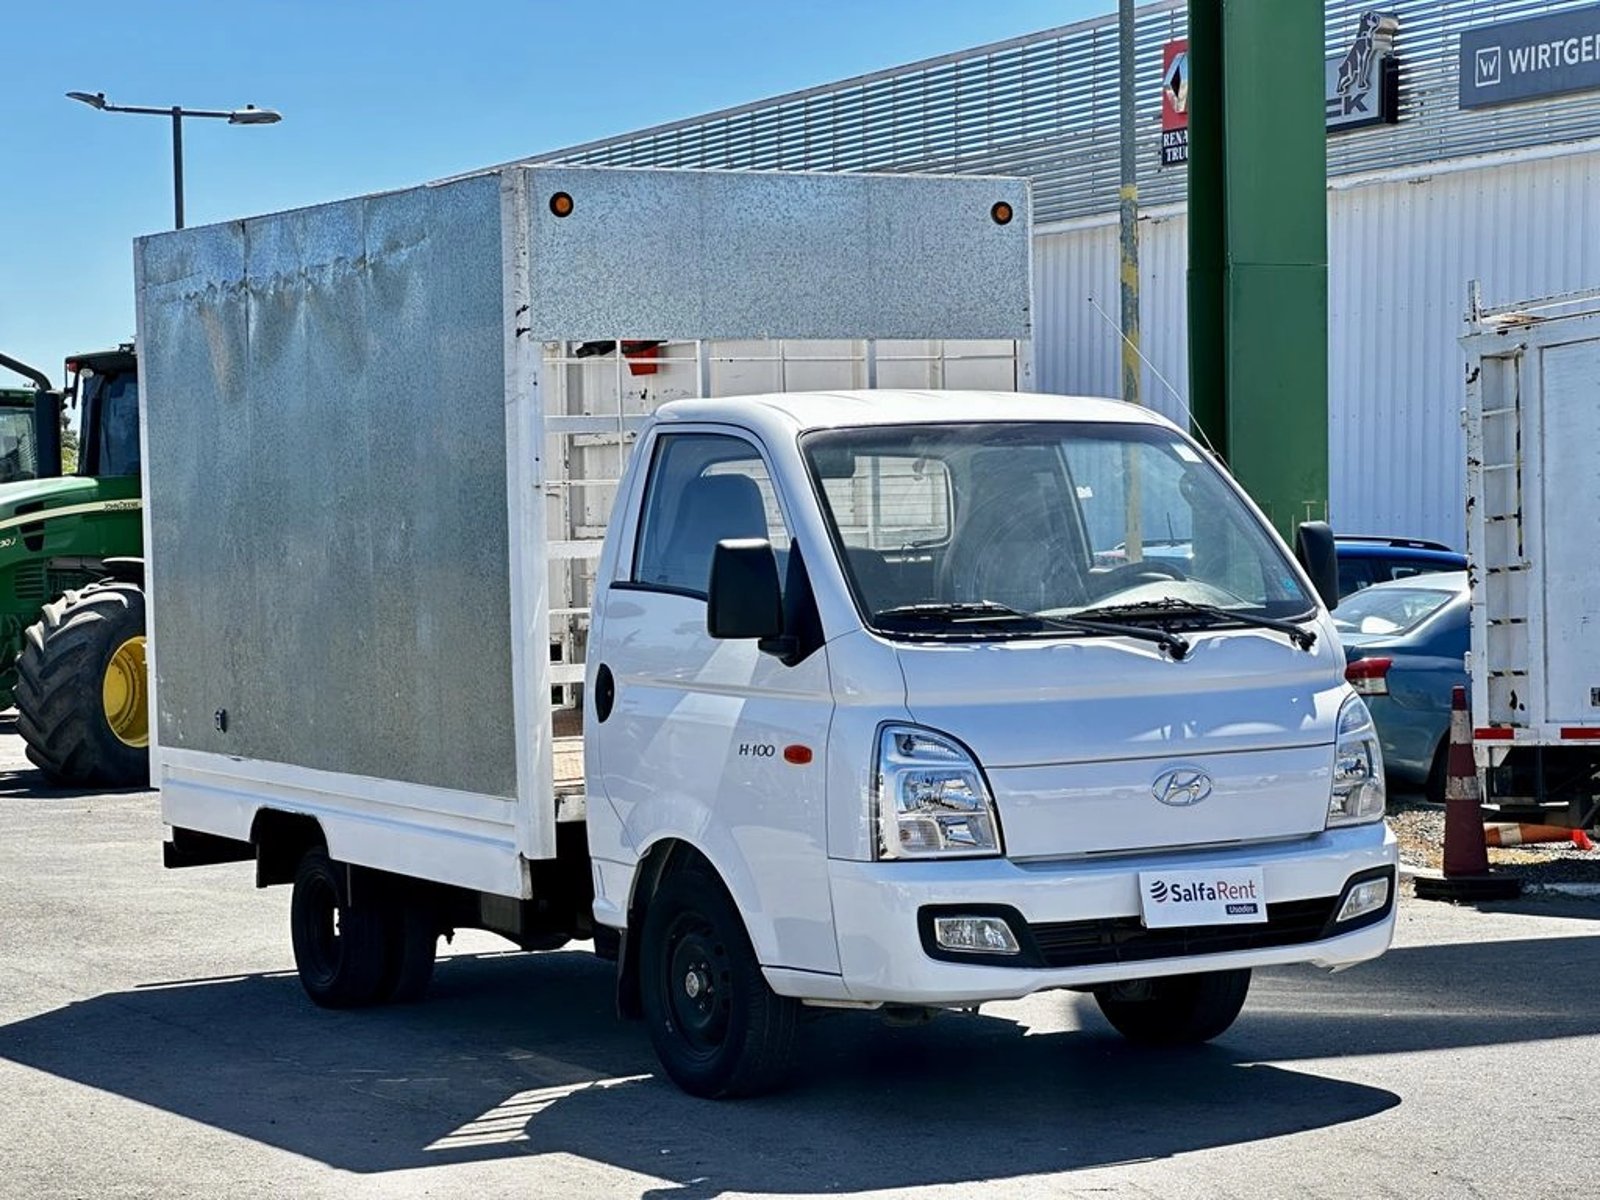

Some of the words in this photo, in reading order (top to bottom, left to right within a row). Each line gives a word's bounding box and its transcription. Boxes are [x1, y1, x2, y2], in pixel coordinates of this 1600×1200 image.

[1163, 130, 1188, 147] RENA
[1165, 145, 1188, 161] TRU
[1170, 880, 1257, 903] SalfaRent
